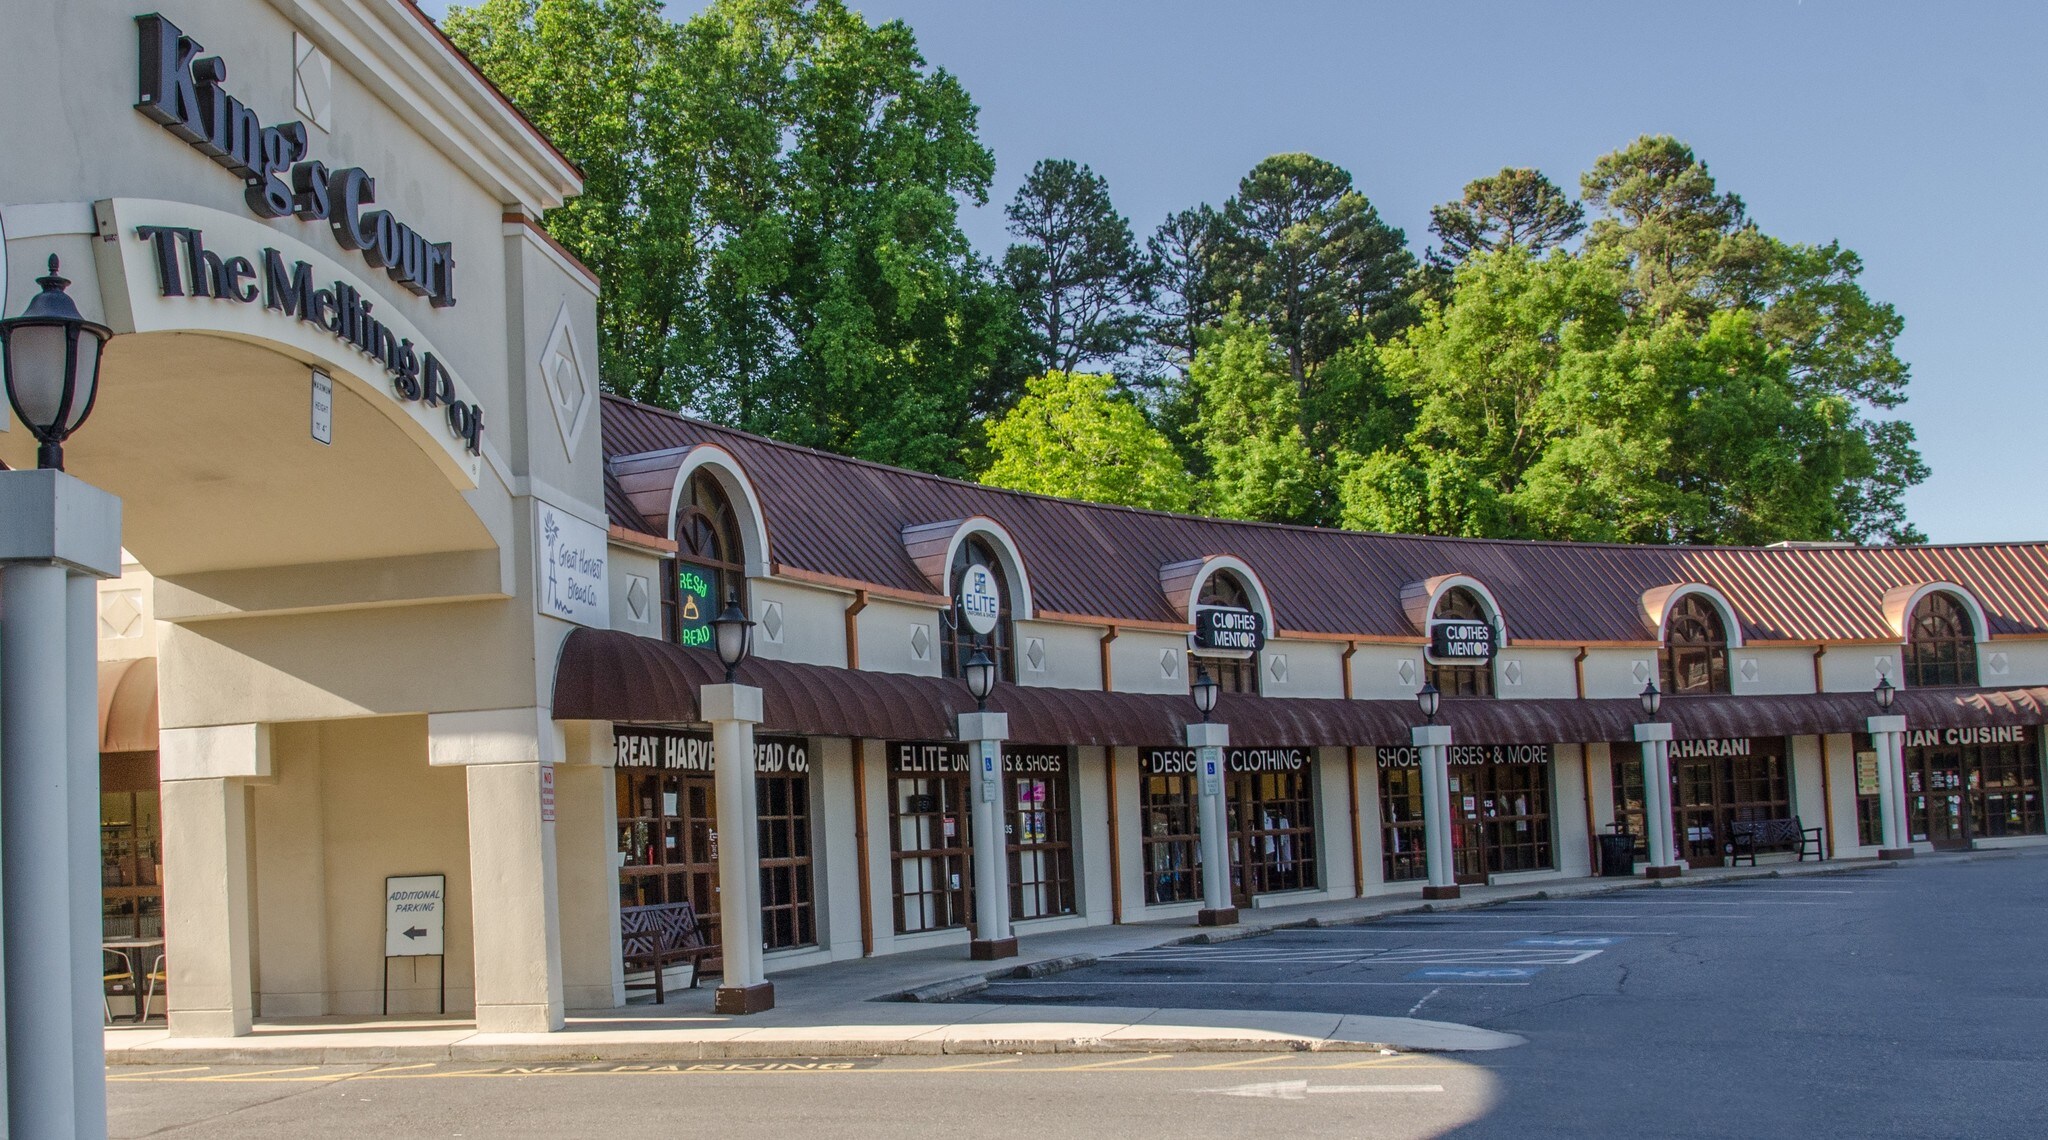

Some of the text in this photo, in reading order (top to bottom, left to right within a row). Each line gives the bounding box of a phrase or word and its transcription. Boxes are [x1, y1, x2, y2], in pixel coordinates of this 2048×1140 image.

[134, 12, 457, 309] King's Court
[137, 225, 484, 457] The Melting Pot
[559, 543, 604, 581] Great Harvest
[567, 577, 587, 604] Bread
[680, 573, 707, 597] RESH
[966, 594, 996, 613] ELITE
[1212, 612, 1256, 630] CLOTHES
[683, 625, 710, 646] READ
[1214, 630, 1256, 648] MENTOR
[1446, 626, 1489, 640] CLOTHES
[1447, 641, 1489, 656] MENTOR
[1945, 725, 2025, 745] CUISINE
[613, 735, 659, 767] REAT
[665, 736, 714, 771] HARVE
[753, 743, 783, 773] READ
[1447, 746, 1484, 765] URSES
[1493, 746, 1504, 764] &
[1508, 745, 1548, 763] MORE
[1668, 739, 1750, 758] AHARANI
[901, 746, 949, 772] ELITE
[1015, 754, 1024, 772] &
[1026, 755, 1060, 772] SHOES
[1152, 750, 1226, 773] DESIG
[1231, 750, 1301, 771] CLOTHING
[1004, 825, 1012, 833] 35
[389, 890, 440, 901] ADDITIONAL
[395, 902, 435, 912] PARKING
[609, 1063, 855, 1073] PARKING
